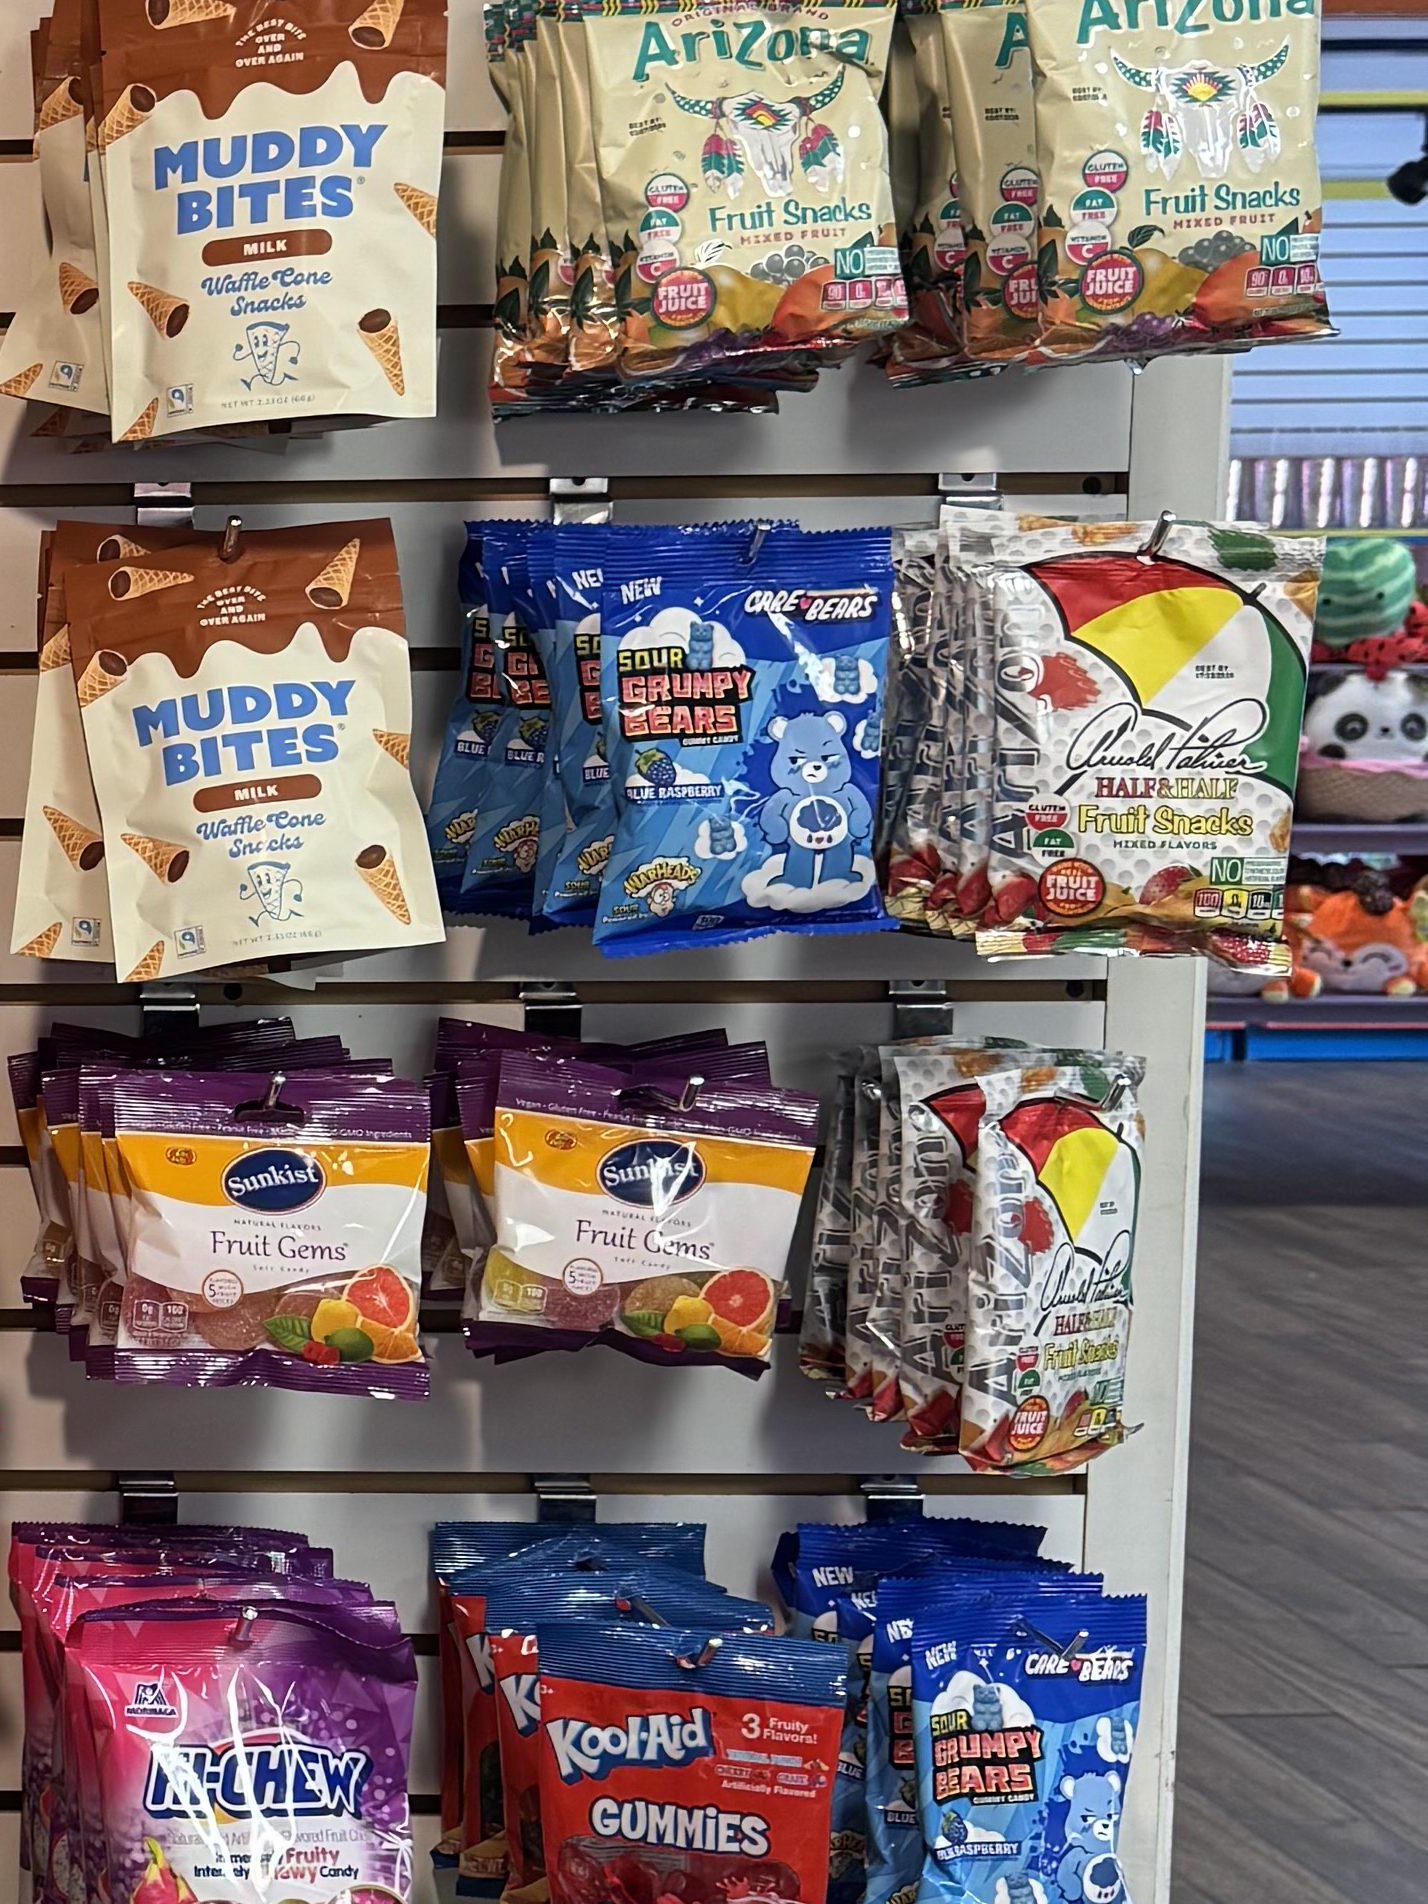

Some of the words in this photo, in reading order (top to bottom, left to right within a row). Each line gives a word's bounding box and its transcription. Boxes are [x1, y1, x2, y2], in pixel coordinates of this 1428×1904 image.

[256, 43, 282, 55] AND
[153, 123, 389, 191] MUDDY
[176, 175, 355, 236] BITES
[1172, 215, 1224, 231] MIXED
[1229, 212, 1276, 227] FRUIT
[242, 239, 288, 258] MILK
[739, 232, 793, 247] MIXED
[800, 227, 848, 240] FRUIT
[200, 273, 271, 299] Waffle
[272, 266, 333, 290] Cone
[657, 283, 709, 303] FRUIT
[230, 293, 307, 318] Snacks
[658, 296, 708, 315] JUICE
[619, 576, 663, 605] NEW
[743, 590, 799, 614] CARE
[804, 592, 879, 622] BEARS
[617, 646, 684, 674] SOUR
[620, 668, 752, 704] GRUMPY
[131, 679, 357, 748] MUDDY
[622, 703, 738, 738] BEARS
[161, 723, 339, 786] BITES
[233, 781, 279, 802] MILK
[227, 1162, 320, 1198] Sunkist
[210, 1230, 271, 1257] Fruit
[277, 1235, 348, 1261] Gems
[575, 1219, 636, 1252] Fruit
[643, 1230, 711, 1261] Gems
[812, 1565, 855, 1586] NEW
[740, 1713, 760, 1739] 3
[762, 1726, 818, 1744] Flavors!
[768, 1716, 810, 1734] Fruity
[545, 1708, 712, 1784] Kool-Aid
[934, 1729, 1044, 1767] GRUMPY
[934, 1763, 1033, 1800] BEARS
[320, 1864, 359, 1881] Candy
